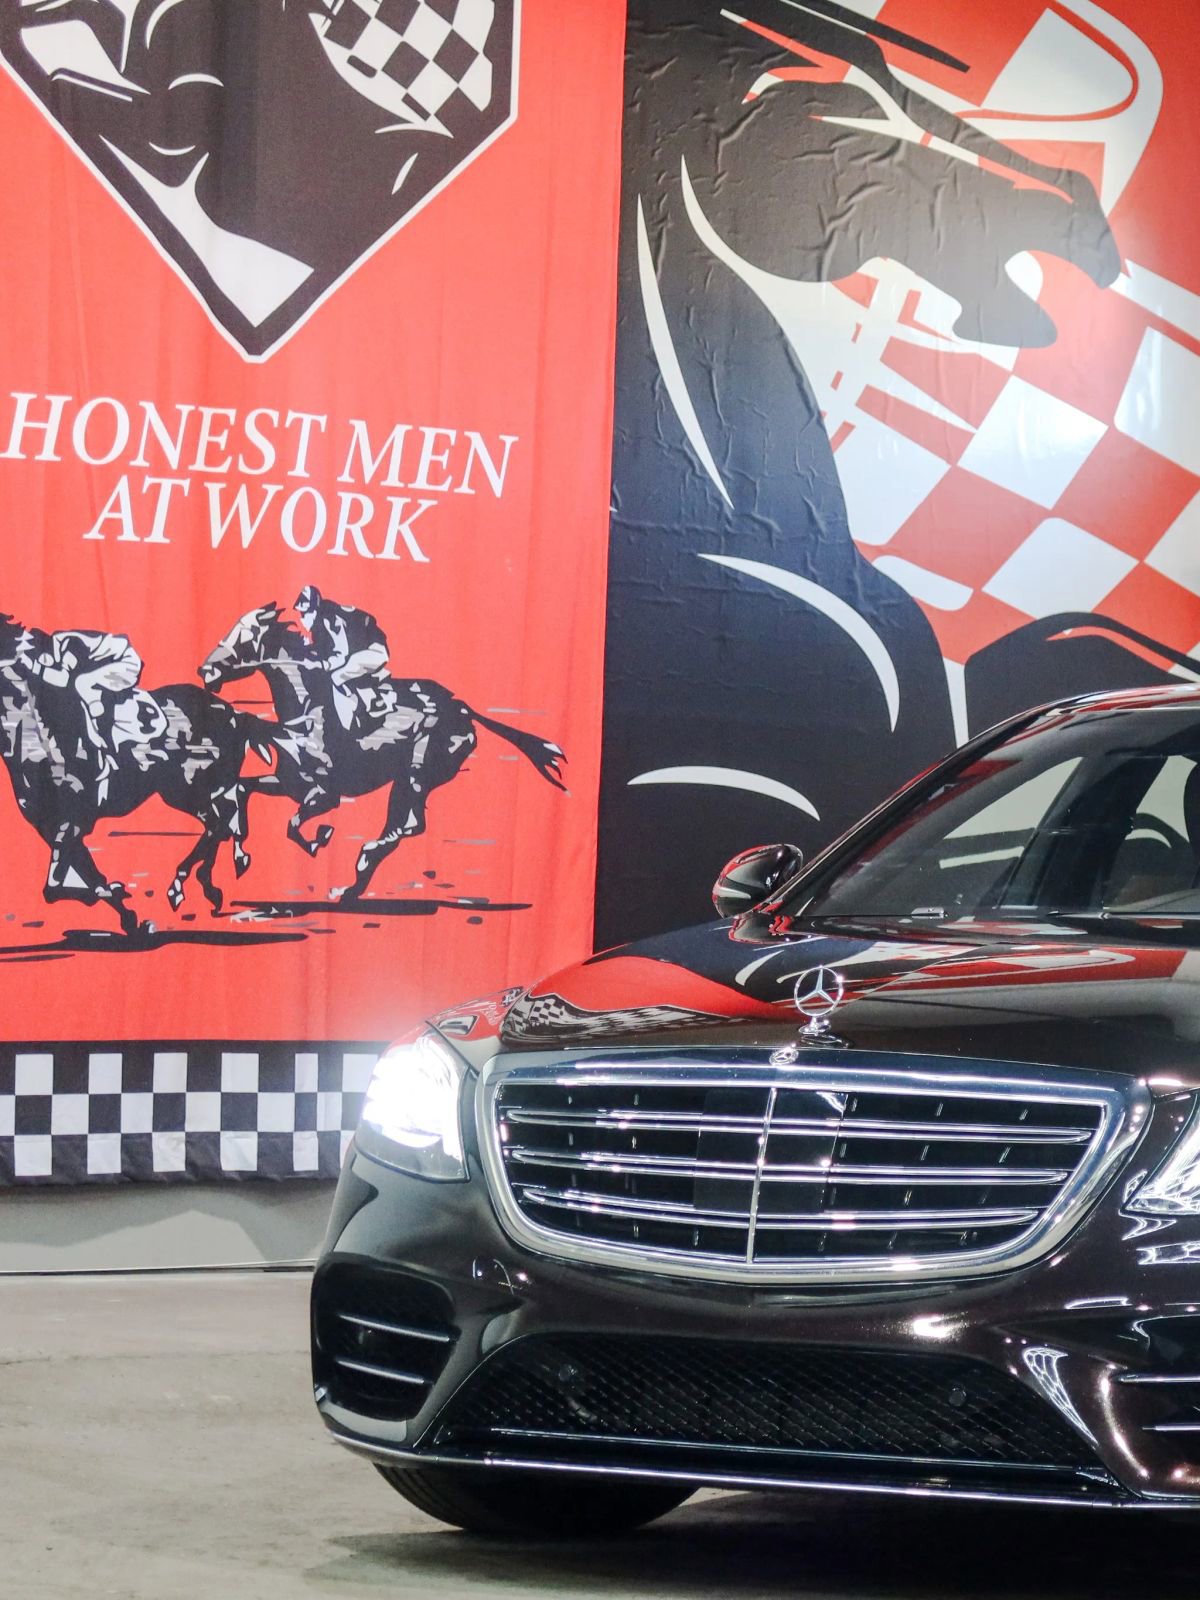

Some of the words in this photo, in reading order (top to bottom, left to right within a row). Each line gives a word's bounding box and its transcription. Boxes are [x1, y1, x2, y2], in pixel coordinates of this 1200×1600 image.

[0, 392, 328, 478] HONEST
[337, 419, 519, 498] MEN
[83, 474, 190, 544] AT
[204, 483, 438, 563] WORK
